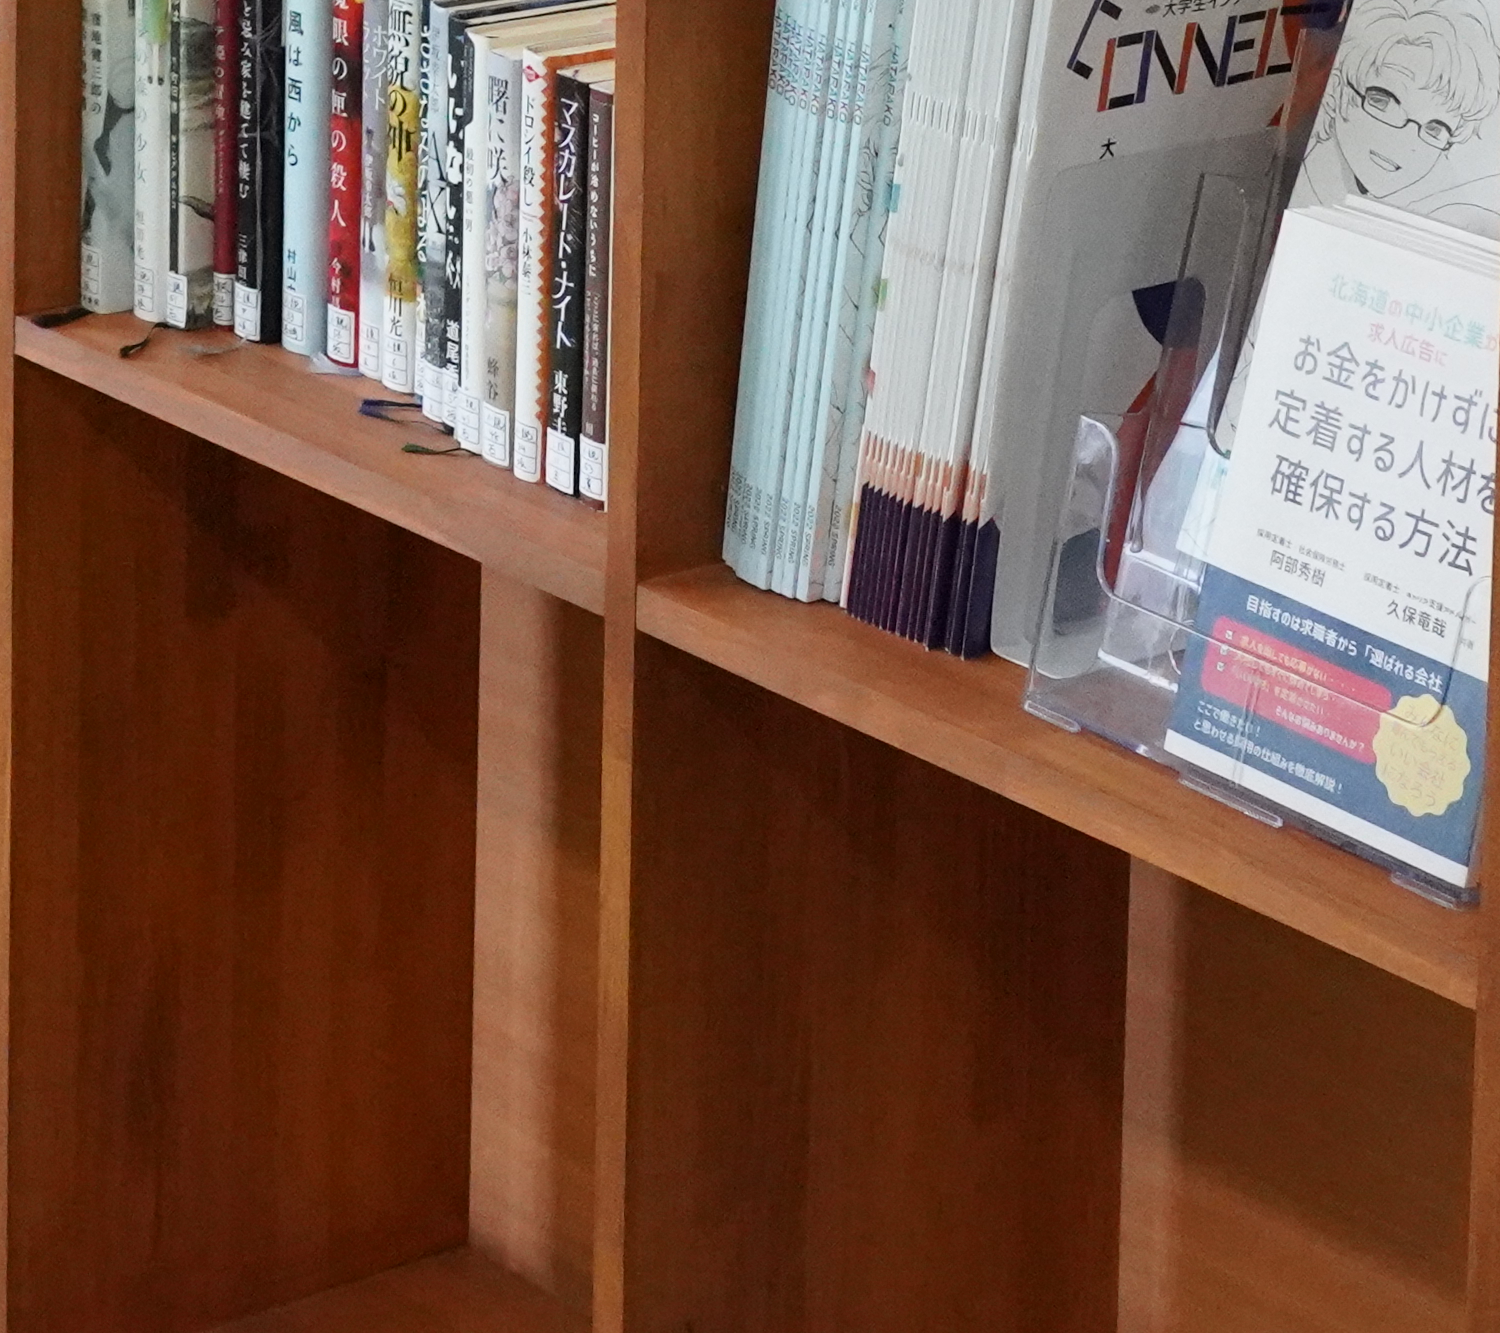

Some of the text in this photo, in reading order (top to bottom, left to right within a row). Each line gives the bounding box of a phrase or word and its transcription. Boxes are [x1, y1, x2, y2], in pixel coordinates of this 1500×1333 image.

[286, 10, 304, 167] 風は西から
[371, 24, 387, 112] ホワイト
[386, 3, 416, 162] 無貌の神
[522, 94, 537, 208] ドロシイ殺し
[588, 113, 599, 278] コーヒーが冷めないうちに
[1100, 138, 1117, 160] 大
[553, 98, 579, 351] マスカレード・ナイト
[1293, 334, 1500, 445] お金をかけずに
[1367, 321, 1448, 367] 求人広告に
[1267, 389, 1496, 517] 定着する人材を
[1268, 453, 1479, 578] 確保する方法
[1269, 548, 1326, 588] 阿部秀樹
[1386, 598, 1448, 640] 久保竜哉
